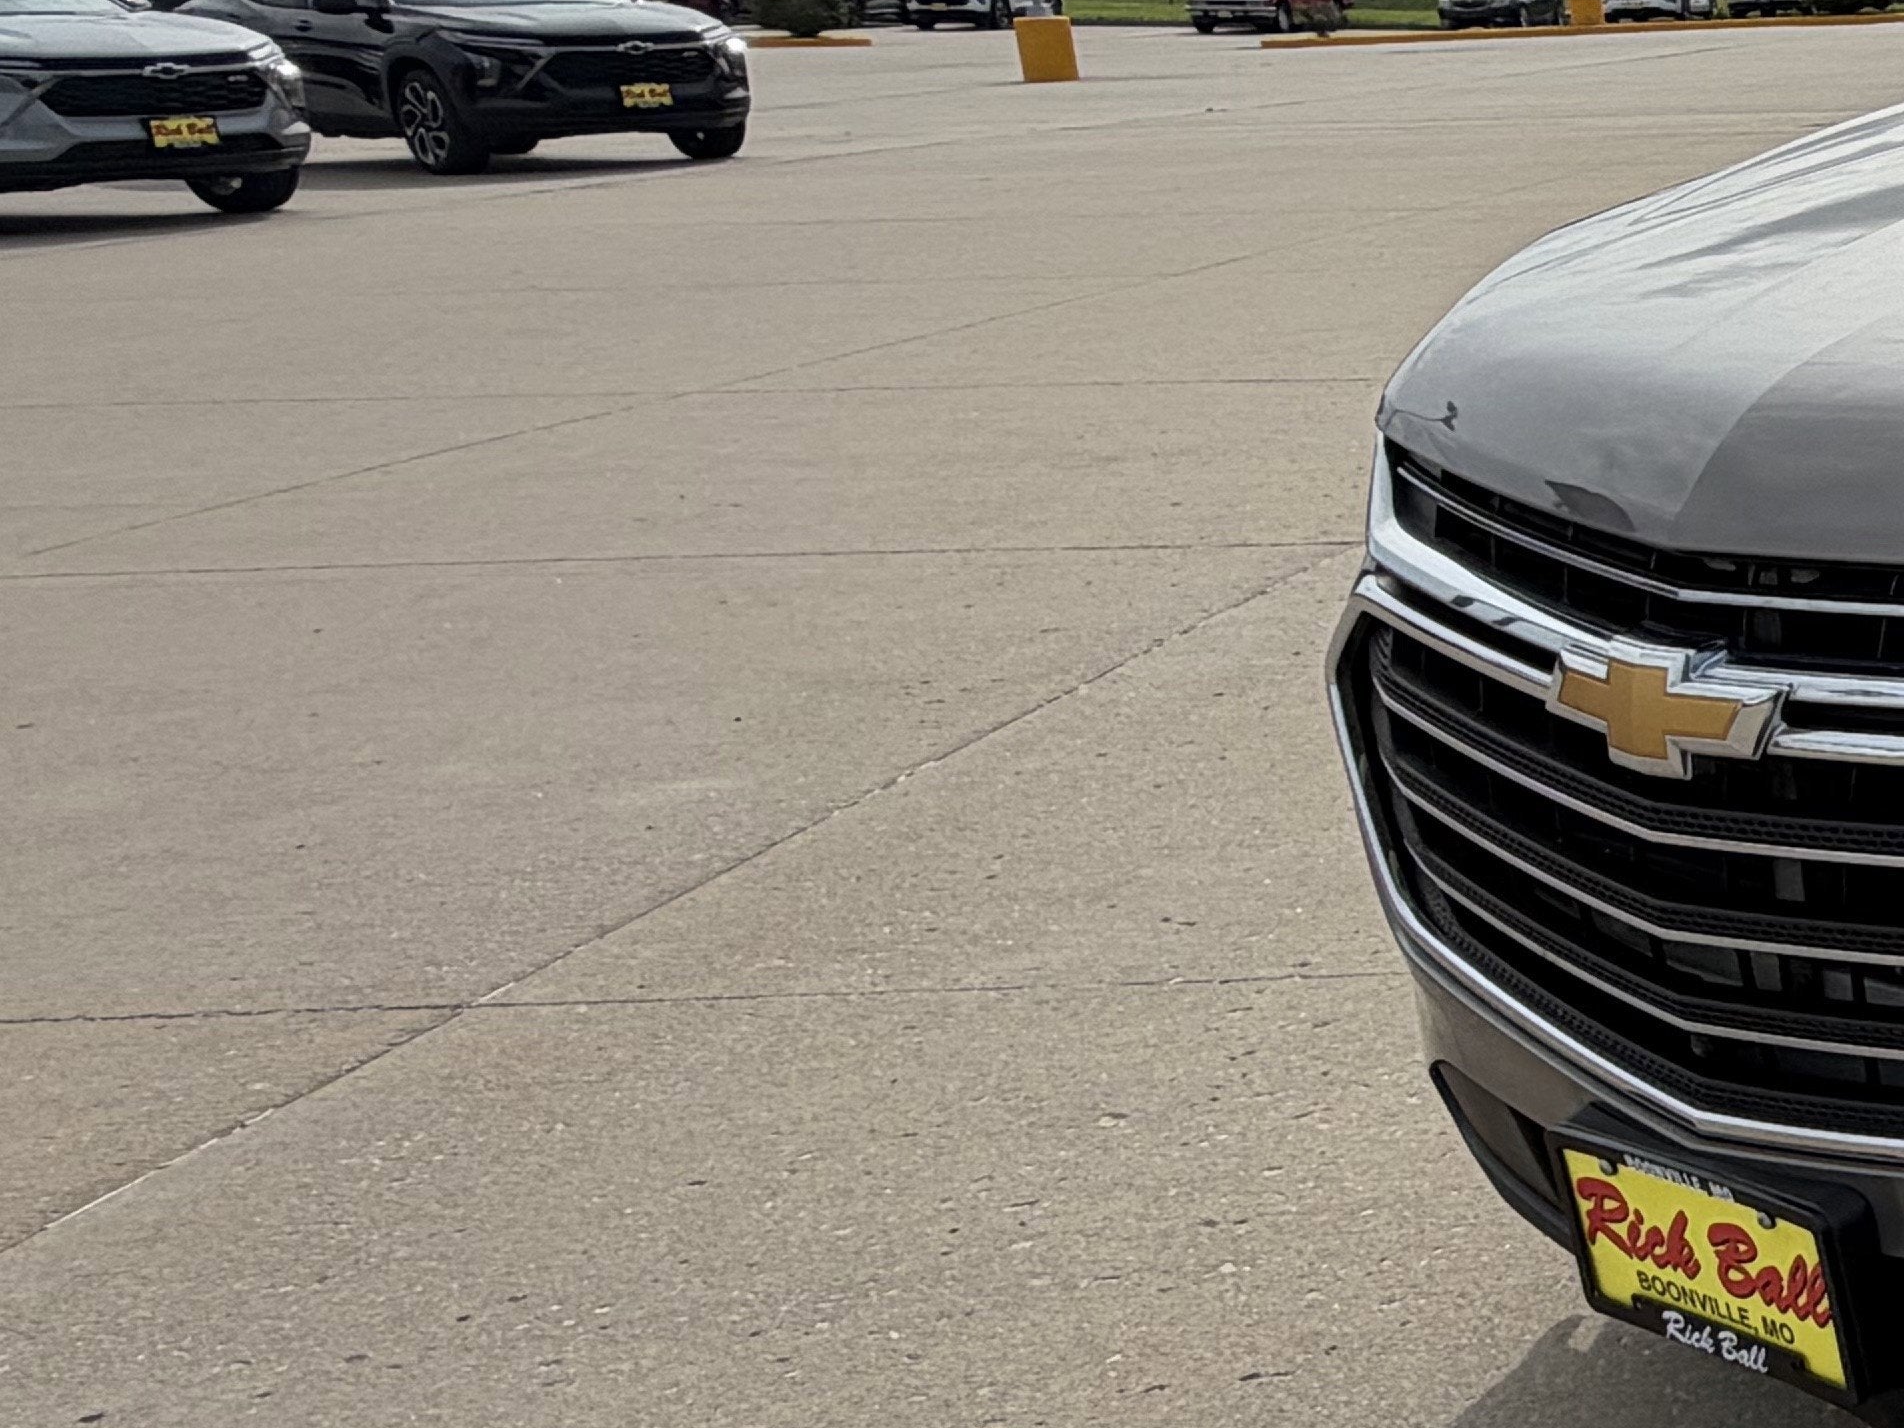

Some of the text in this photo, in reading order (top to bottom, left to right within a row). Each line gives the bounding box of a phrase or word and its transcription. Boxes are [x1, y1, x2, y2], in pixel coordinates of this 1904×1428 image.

[1576, 1177, 1833, 1328] Rick Ball
[1636, 1270, 1795, 1346] BOONVILLE, MO
[1662, 1310, 1768, 1374] Rick Ball
